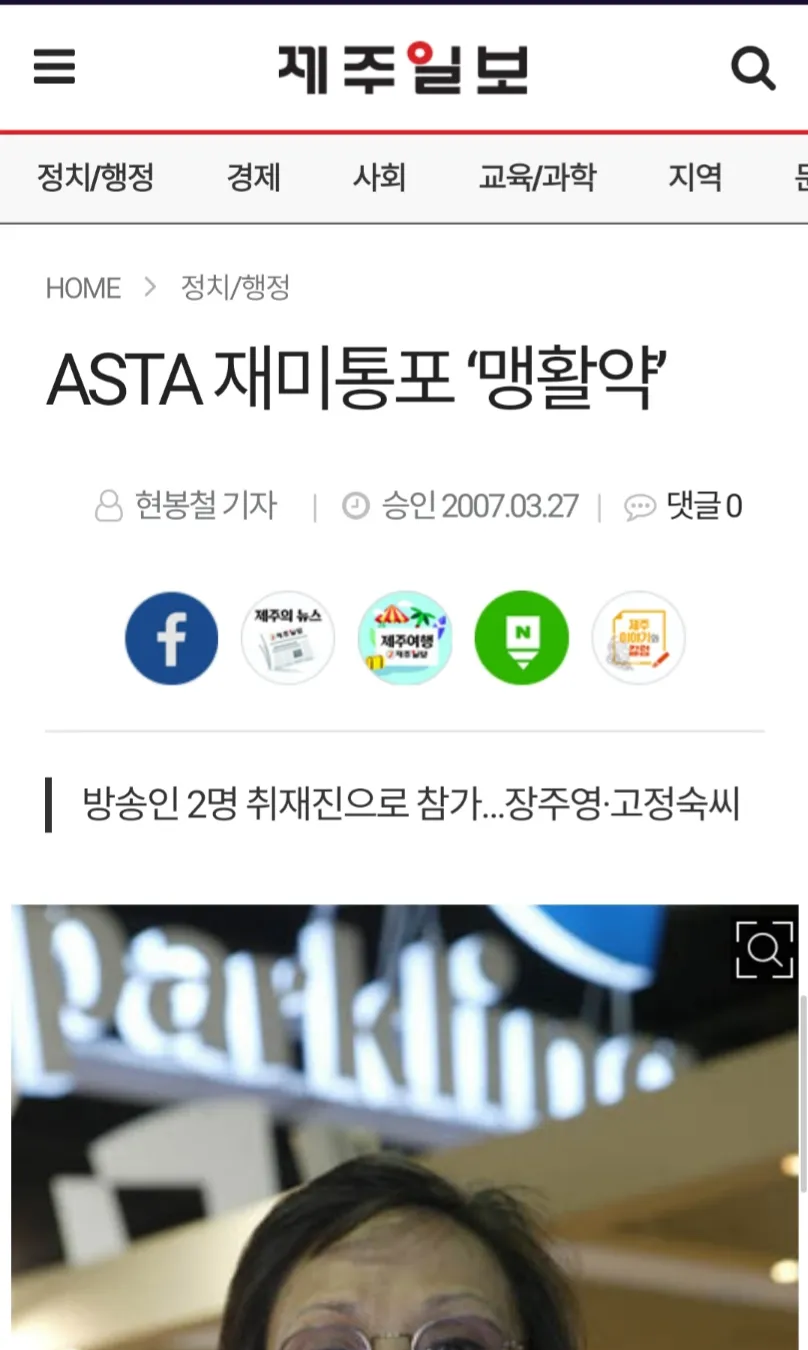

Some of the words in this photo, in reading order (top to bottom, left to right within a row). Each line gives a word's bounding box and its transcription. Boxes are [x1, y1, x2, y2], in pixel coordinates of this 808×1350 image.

[279, 41, 527, 95] 제주일보
[38, 162, 152, 192] 정치/행정
[228, 162, 279, 192] 경제
[353, 162, 404, 192] 사회
[479, 162, 597, 192] 교육/과학
[669, 162, 721, 192] 지역
[47, 277, 121, 298] HOME
[182, 274, 288, 300] 정치/행정
[46, 352, 204, 406] ASTA
[214, 345, 455, 410] 재미통포
[136, 490, 215, 520] 현봉철
[224, 490, 277, 520] 기자
[383, 490, 435, 520] 승인
[442, 494, 579, 517] 2007.03.27
[668, 490, 721, 520] 댓글
[727, 493, 742, 518] 0
[255, 609, 293, 622] 제주의
[297, 609, 322, 622] 뉴스
[381, 634, 434, 648] 제주여행
[84, 786, 178, 821] 방송인
[188, 786, 236, 821] 2명
[247, 786, 409, 821] 취재진으로
